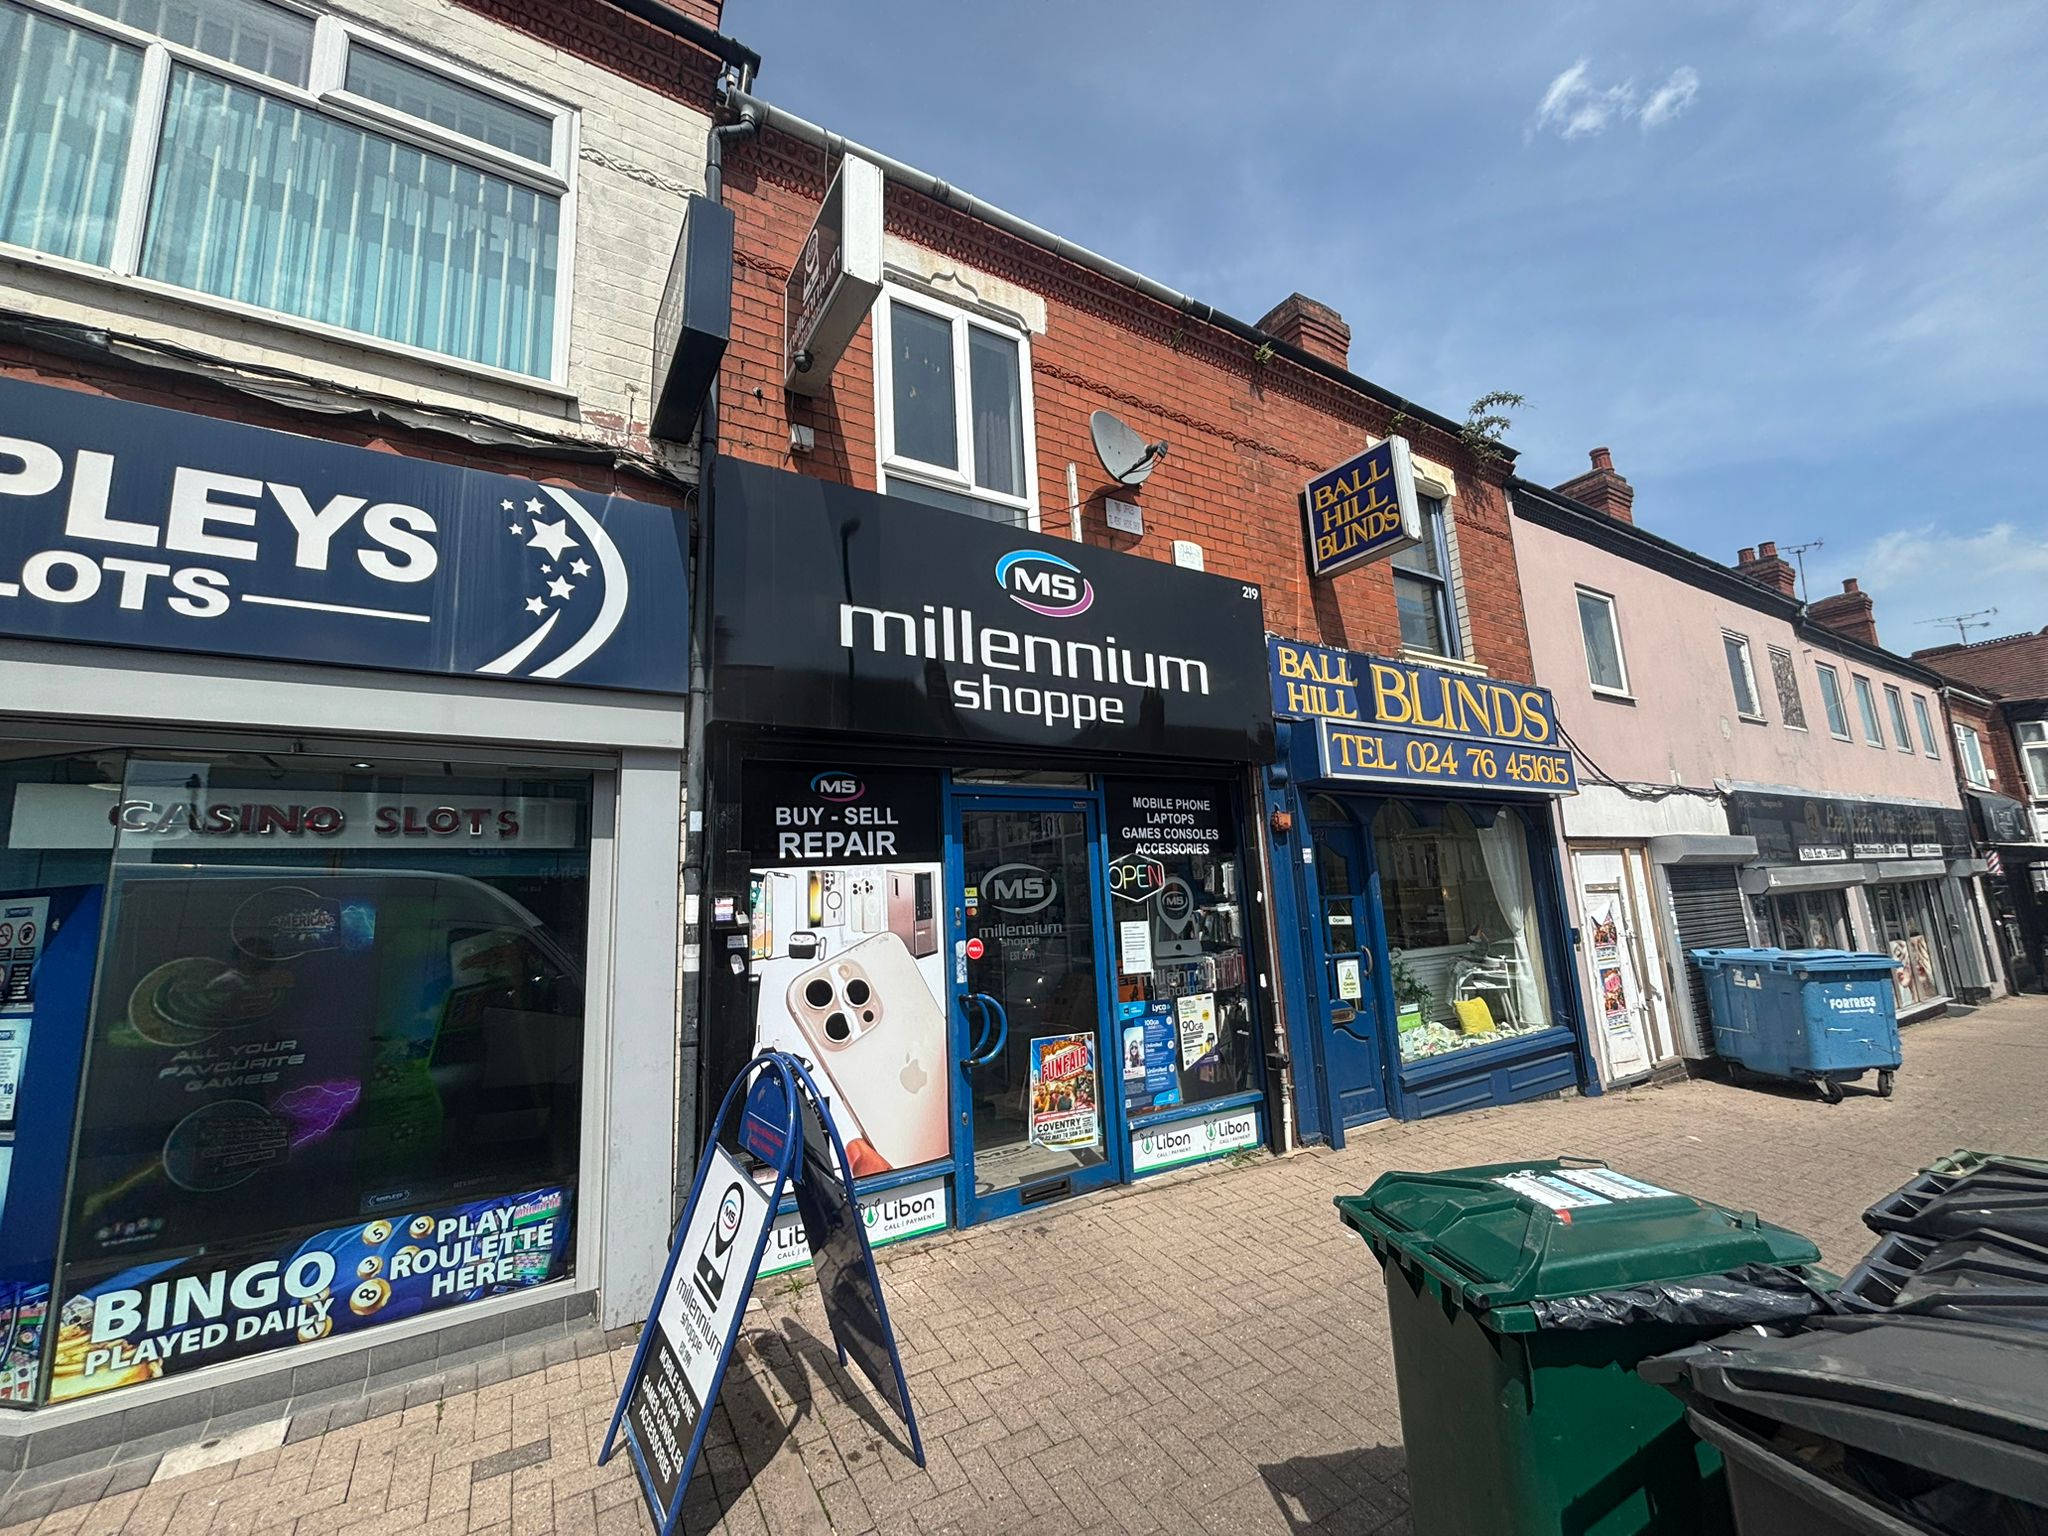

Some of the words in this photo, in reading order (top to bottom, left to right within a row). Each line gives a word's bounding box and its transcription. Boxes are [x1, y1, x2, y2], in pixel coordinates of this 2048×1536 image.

[1314, 458, 1390, 512] BALL
[1322, 486, 1389, 534] HILL
[1317, 504, 1401, 563] BLINDS
[0, 550, 231, 618] OTS
[1014, 567, 1076, 601] MS
[1241, 586, 1259, 600] 219
[839, 603, 1210, 696] millennium
[1277, 645, 1358, 687] BALL
[953, 675, 1125, 730] shoppe
[1287, 683, 1358, 719] HILL
[1370, 662, 1549, 743] BLINDS
[1331, 732, 1397, 770] TEL
[1406, 741, 1458, 776] 024
[1467, 748, 1497, 779] 76
[1505, 751, 1569, 785] 451615
[820, 780, 856, 793] MS
[775, 807, 824, 826] BUY
[844, 807, 899, 825] SELL
[1132, 797, 1173, 809] MOBILE
[1175, 799, 1211, 811] PHONE
[109, 801, 345, 836] CASINO
[375, 806, 520, 838] SLOTS
[1146, 812, 1194, 825] LAPTOPS
[779, 831, 898, 859] REPAIR
[1122, 827, 1161, 839] GAMES
[1164, 828, 1219, 840] CONSOLES
[1135, 842, 1210, 855] ACCESSORIES
[994, 877, 1045, 900] MS
[1109, 864, 1162, 889] OPEN
[979, 922, 1063, 938] millennium
[1000, 936, 1040, 948] shoppe
[1151, 1004, 1167, 1012] Lyca
[1829, 996, 1876, 1009] FORTRESS
[171, 1049, 219, 1062] ALL
[229, 1040, 297, 1055] YOUR
[1041, 1046, 1088, 1084] FUNFAIR
[158, 1054, 306, 1079] FAVOURITE
[185, 1072, 279, 1092] GAMES
[1037, 1118, 1081, 1133] COVENTRY
[1219, 1120, 1250, 1137] Libon
[1156, 1133, 1192, 1150] Libon
[725, 1206, 737, 1224] MS
[884, 1197, 935, 1221] Libon
[884, 1223, 900, 1232] CALL
[906, 1212, 935, 1225] PAYMENT
[437, 1205, 517, 1243] PLAY
[777, 1225, 807, 1249] Lib
[390, 1223, 553, 1281] ROULETTE
[777, 1251, 796, 1260] CALL
[432, 1256, 516, 1297] HERE
[91, 1251, 336, 1344] BINGO
[676, 1277, 723, 1361] millennium
[84, 1323, 229, 1376] PLAYED
[235, 1298, 334, 1342] DAILY
[680, 1312, 703, 1355] shoppe
[659, 1346, 679, 1389] MOBILE
[675, 1380, 695, 1425] PHONE
[657, 1374, 680, 1428] LAPTOPS
[642, 1374, 659, 1415] GAMES
[657, 1408, 683, 1474] CONSOLES
[639, 1403, 671, 1484] ACCESSORIES
